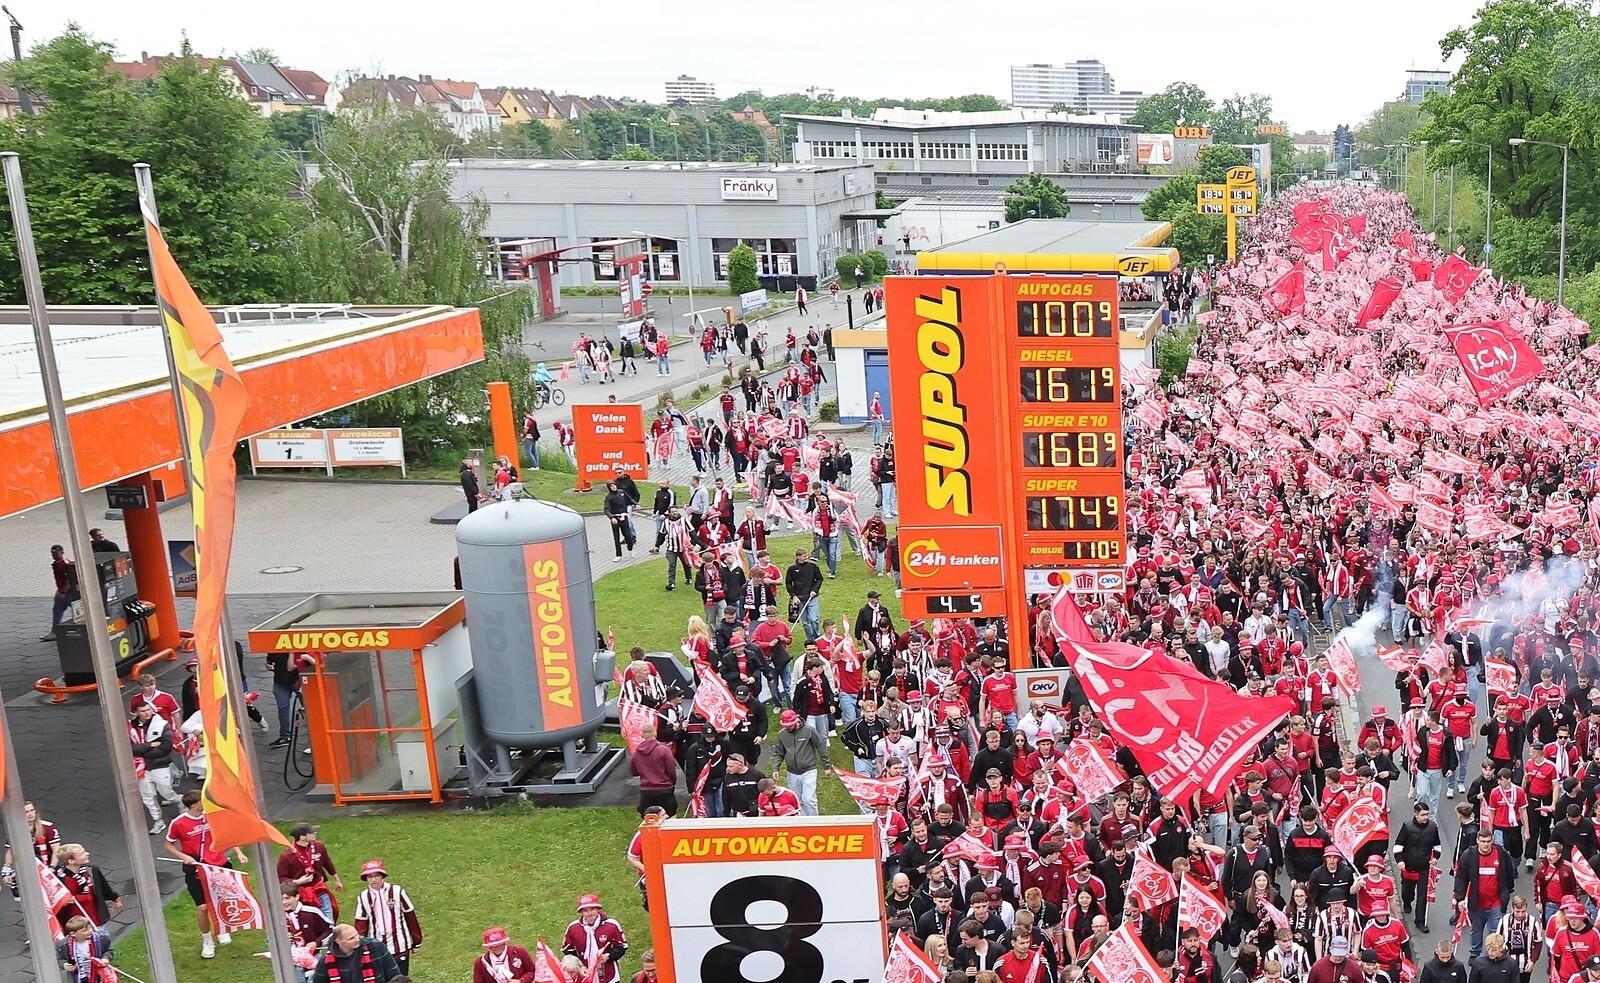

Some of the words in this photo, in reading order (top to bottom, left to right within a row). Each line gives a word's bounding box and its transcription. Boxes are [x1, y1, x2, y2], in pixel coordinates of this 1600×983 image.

[1174, 127, 1208, 139] OBI
[1230, 170, 1252, 180] JET
[723, 179, 774, 196] Fränky
[1123, 261, 1149, 272] JET
[1017, 283, 1094, 296] AUTOGAS
[1020, 350, 1073, 362] DIESEL
[914, 286, 971, 517] SUPOL
[591, 413, 627, 423] Vielen
[1023, 415, 1074, 427] SUPER
[1078, 415, 1108, 427] E10
[595, 425, 625, 434] Dank
[602, 450, 624, 459] und
[585, 463, 610, 472] gute
[1026, 479, 1078, 491] SUPER
[1030, 546, 1063, 554] ADBLUE
[910, 552, 946, 567] 24h
[950, 555, 999, 565] tanken
[533, 559, 574, 708] AUTOGAS
[275, 631, 389, 650] AUTOGAS
[118, 637, 130, 658] 6
[1031, 681, 1055, 691] DKV
[672, 831, 864, 857] AUTOWÄSCHE
